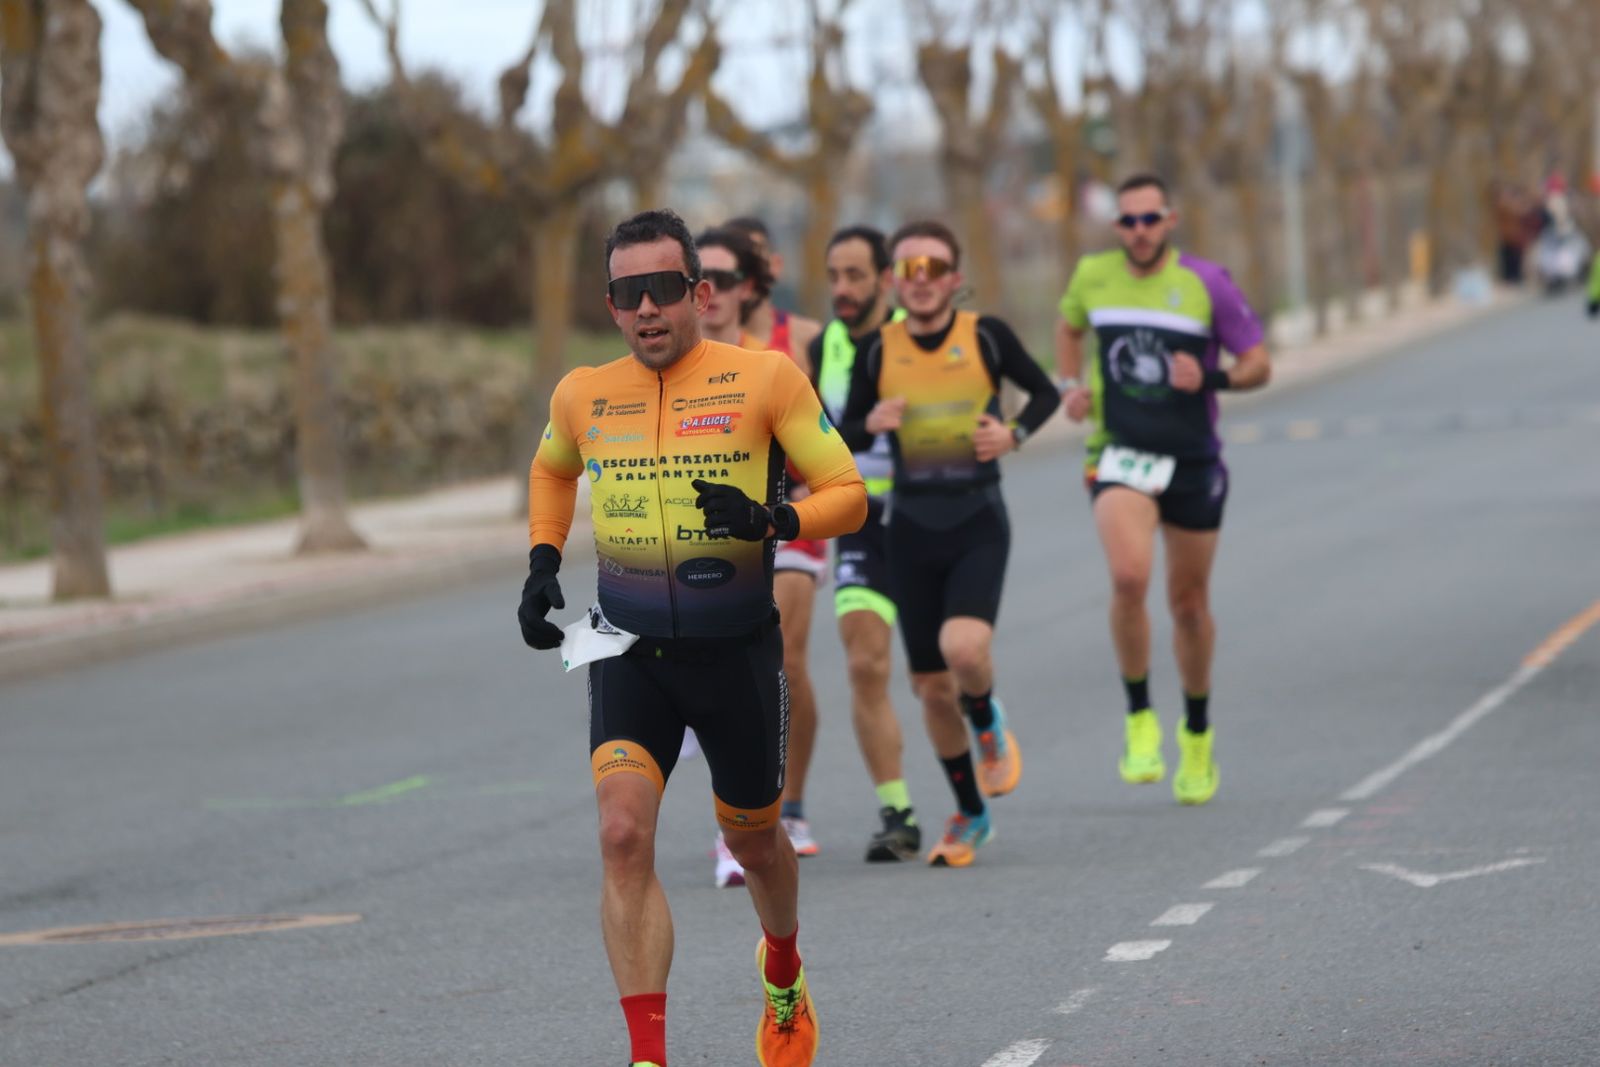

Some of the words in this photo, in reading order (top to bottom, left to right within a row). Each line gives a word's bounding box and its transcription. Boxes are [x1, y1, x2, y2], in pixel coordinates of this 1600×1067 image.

[607, 402, 647, 411] Ayuntamiento
[718, 398, 744, 406] DENTAL
[701, 415, 732, 426] ELICES
[603, 456, 667, 468] ESCUELA
[615, 469, 730, 481] SALMANTINA
[608, 535, 658, 545] ALTAFIT
[688, 572, 722, 580] HERRERO
